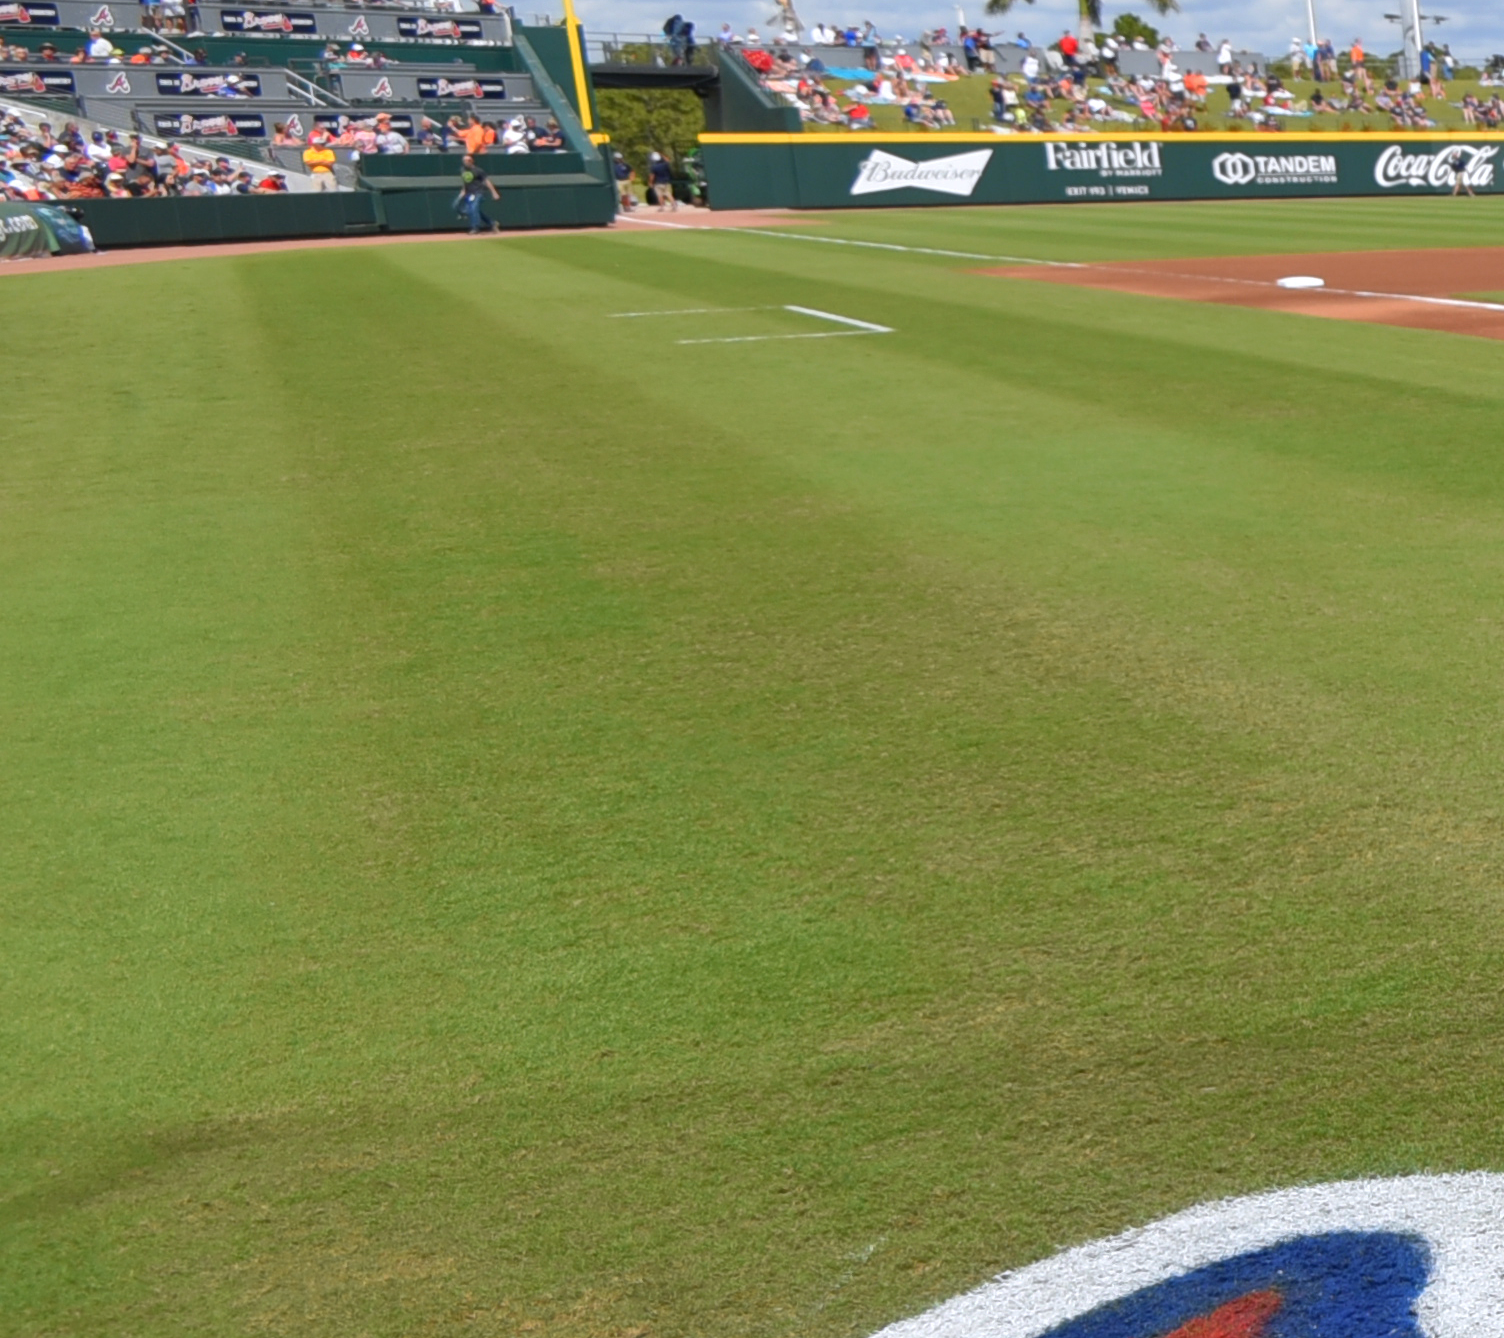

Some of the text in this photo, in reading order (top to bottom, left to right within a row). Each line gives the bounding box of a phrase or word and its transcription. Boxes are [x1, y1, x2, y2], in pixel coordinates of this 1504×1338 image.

[1044, 141, 1161, 170] Fairfield
[1255, 155, 1336, 174] TANDEM
[860, 159, 982, 182] Budweiser
[1114, 168, 1163, 177] MARRIOTT
[1256, 175, 1338, 184] CONSTRUCTION
